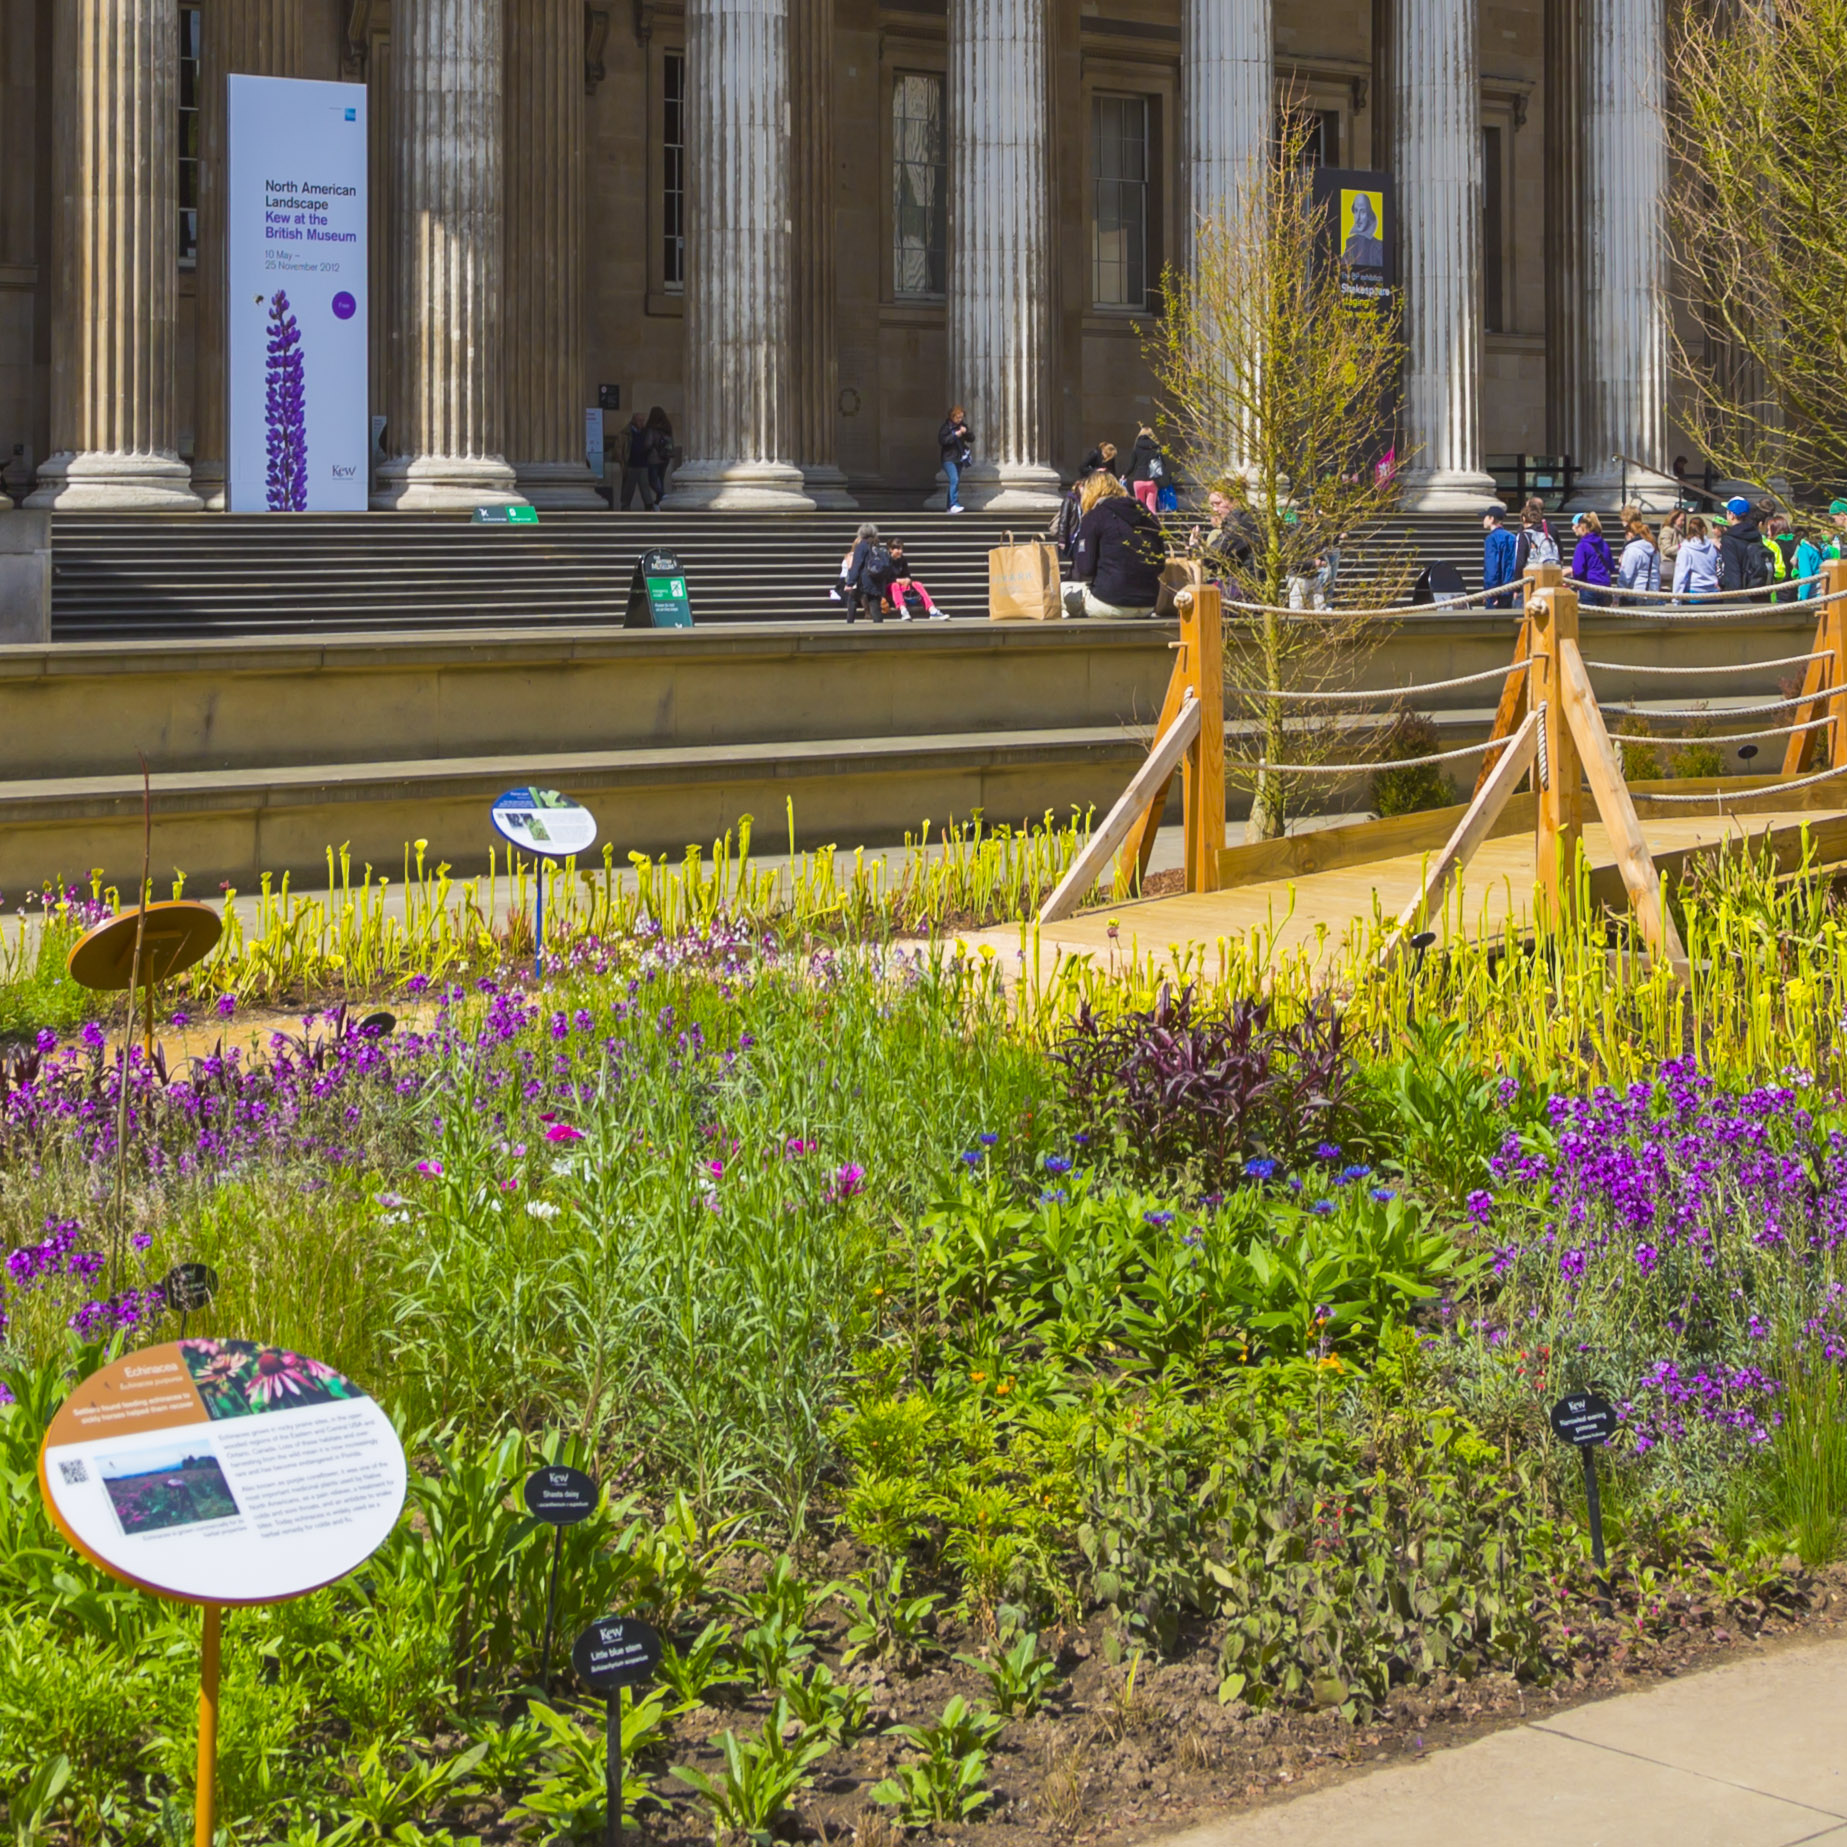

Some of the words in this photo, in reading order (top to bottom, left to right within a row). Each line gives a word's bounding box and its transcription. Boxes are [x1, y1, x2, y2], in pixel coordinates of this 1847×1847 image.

[265, 180, 297, 193] North
[302, 182, 356, 196] American
[265, 196, 328, 211] Landscape
[265, 212, 290, 223] Kew
[294, 213, 305, 224] at
[309, 214, 327, 225] the
[265, 226, 302, 240] British
[307, 229, 356, 242] Museum
[265, 250, 274, 258] 10
[276, 250, 292, 261] May
[265, 260, 276, 270] 25
[279, 262, 317, 271] November
[320, 263, 340, 272] 2012
[332, 465, 356, 477] Kew
[125, 1363, 178, 1378] Echinacea
[102, 1403, 120, 1411] found
[122, 1400, 147, 1408] feeding
[149, 1394, 182, 1404] echinacea
[102, 1413, 125, 1421] horses
[126, 1407, 149, 1417] helped
[549, 1473, 569, 1483] Kew
[600, 1625, 623, 1640] Kew
[590, 1651, 608, 1661] Little
[609, 1647, 624, 1657] blue
